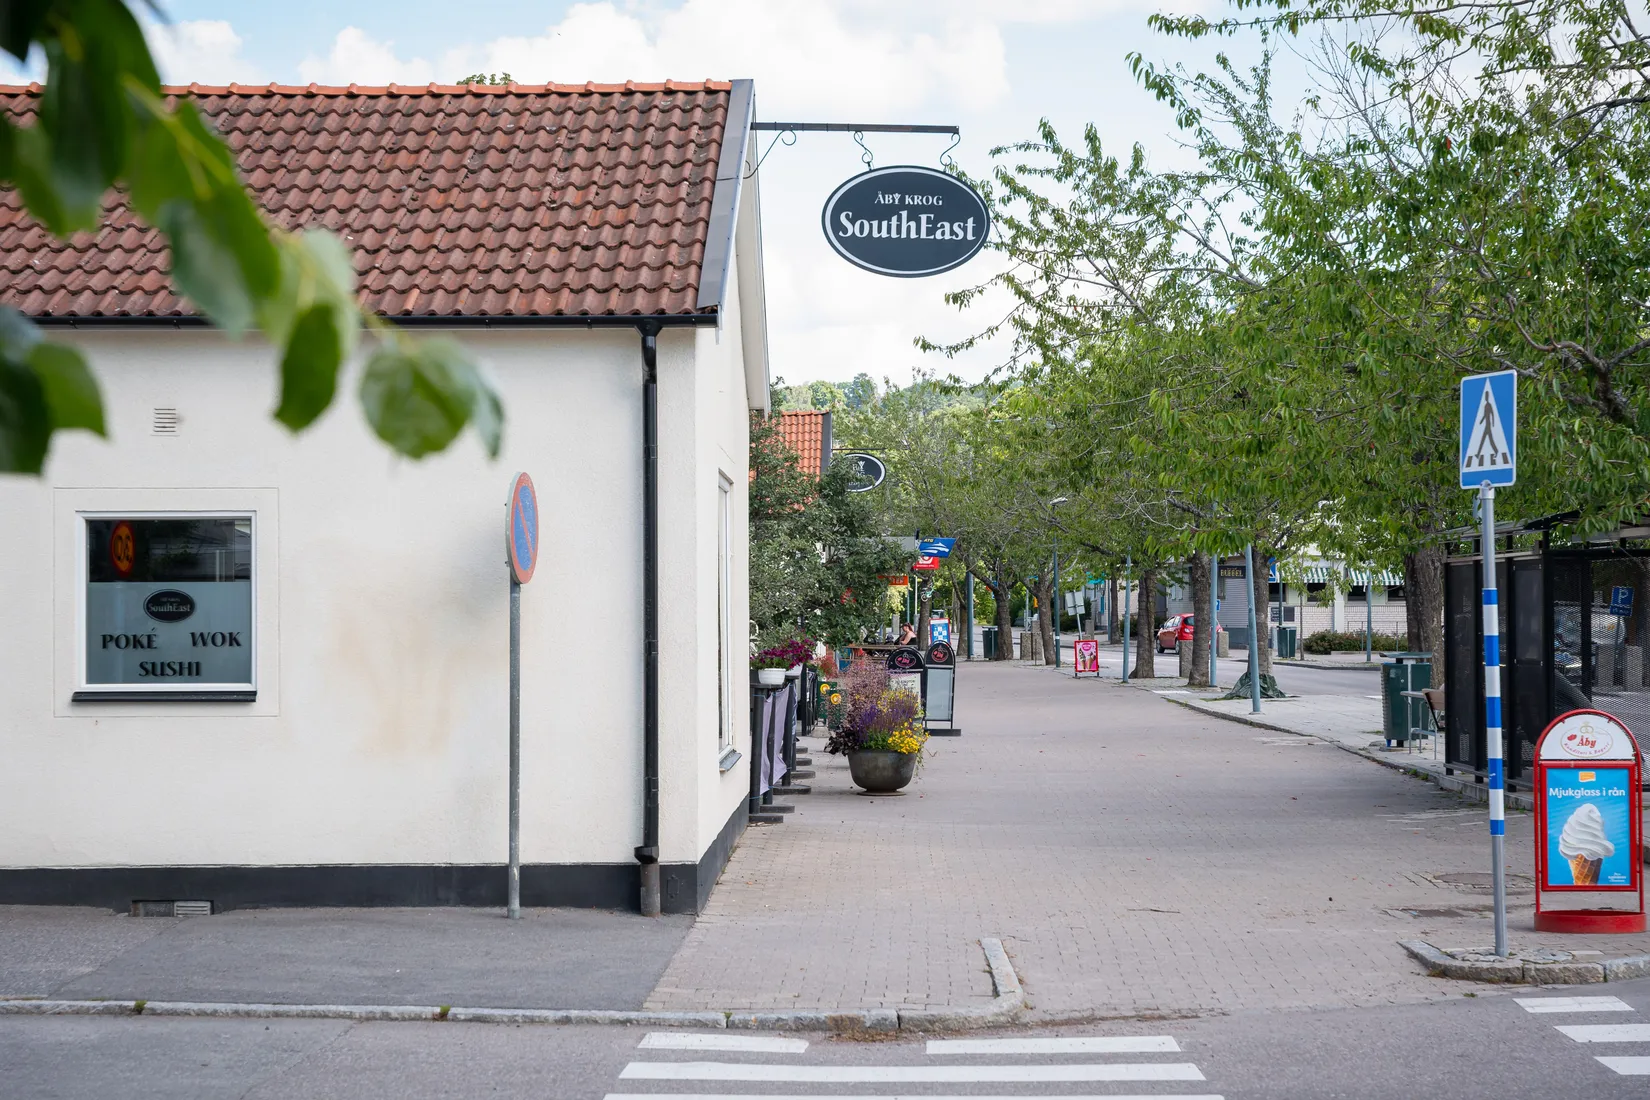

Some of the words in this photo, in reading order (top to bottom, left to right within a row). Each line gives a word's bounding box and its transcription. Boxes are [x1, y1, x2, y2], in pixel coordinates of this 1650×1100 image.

[875, 191, 901, 205] ÅBY
[905, 195, 943, 206] KROG
[838, 210, 976, 241] SouthEast
[1618, 589, 1629, 604] P
[148, 602, 191, 612] SouthEast
[101, 627, 158, 650] POKÉ
[190, 631, 242, 648] WOK
[139, 661, 202, 677] SUSHI
[1577, 735, 1597, 749] Åby
[1549, 787, 1601, 799] Mjukglass
[1602, 787, 1606, 797] i
[1608, 787, 1626, 797] rån
